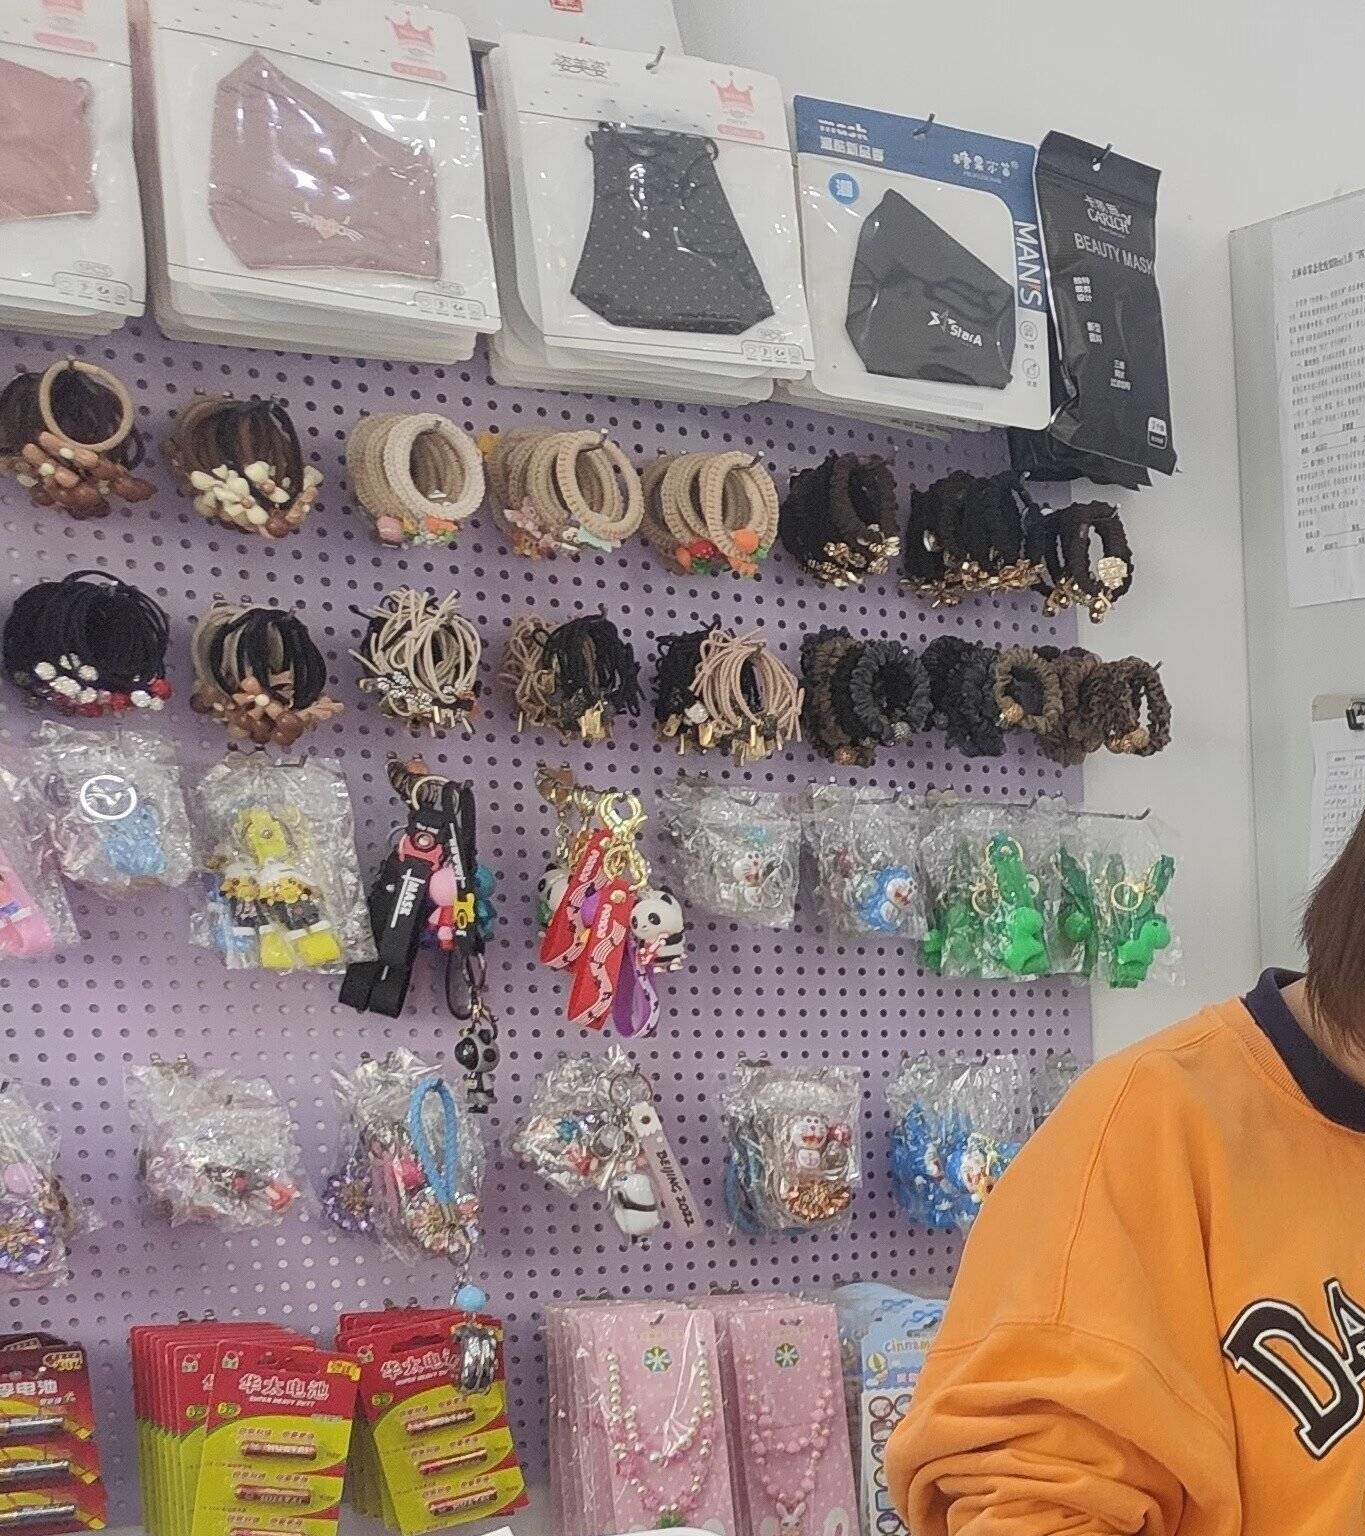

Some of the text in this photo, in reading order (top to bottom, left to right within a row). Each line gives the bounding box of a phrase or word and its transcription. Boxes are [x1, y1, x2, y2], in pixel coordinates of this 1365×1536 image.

[1014, 221, 1043, 306] MAN'S
[1073, 232, 1120, 263] BEAUTY
[655, 1149, 696, 1229] BEIJING 2022
[238, 1373, 330, 1402] 华太电池
